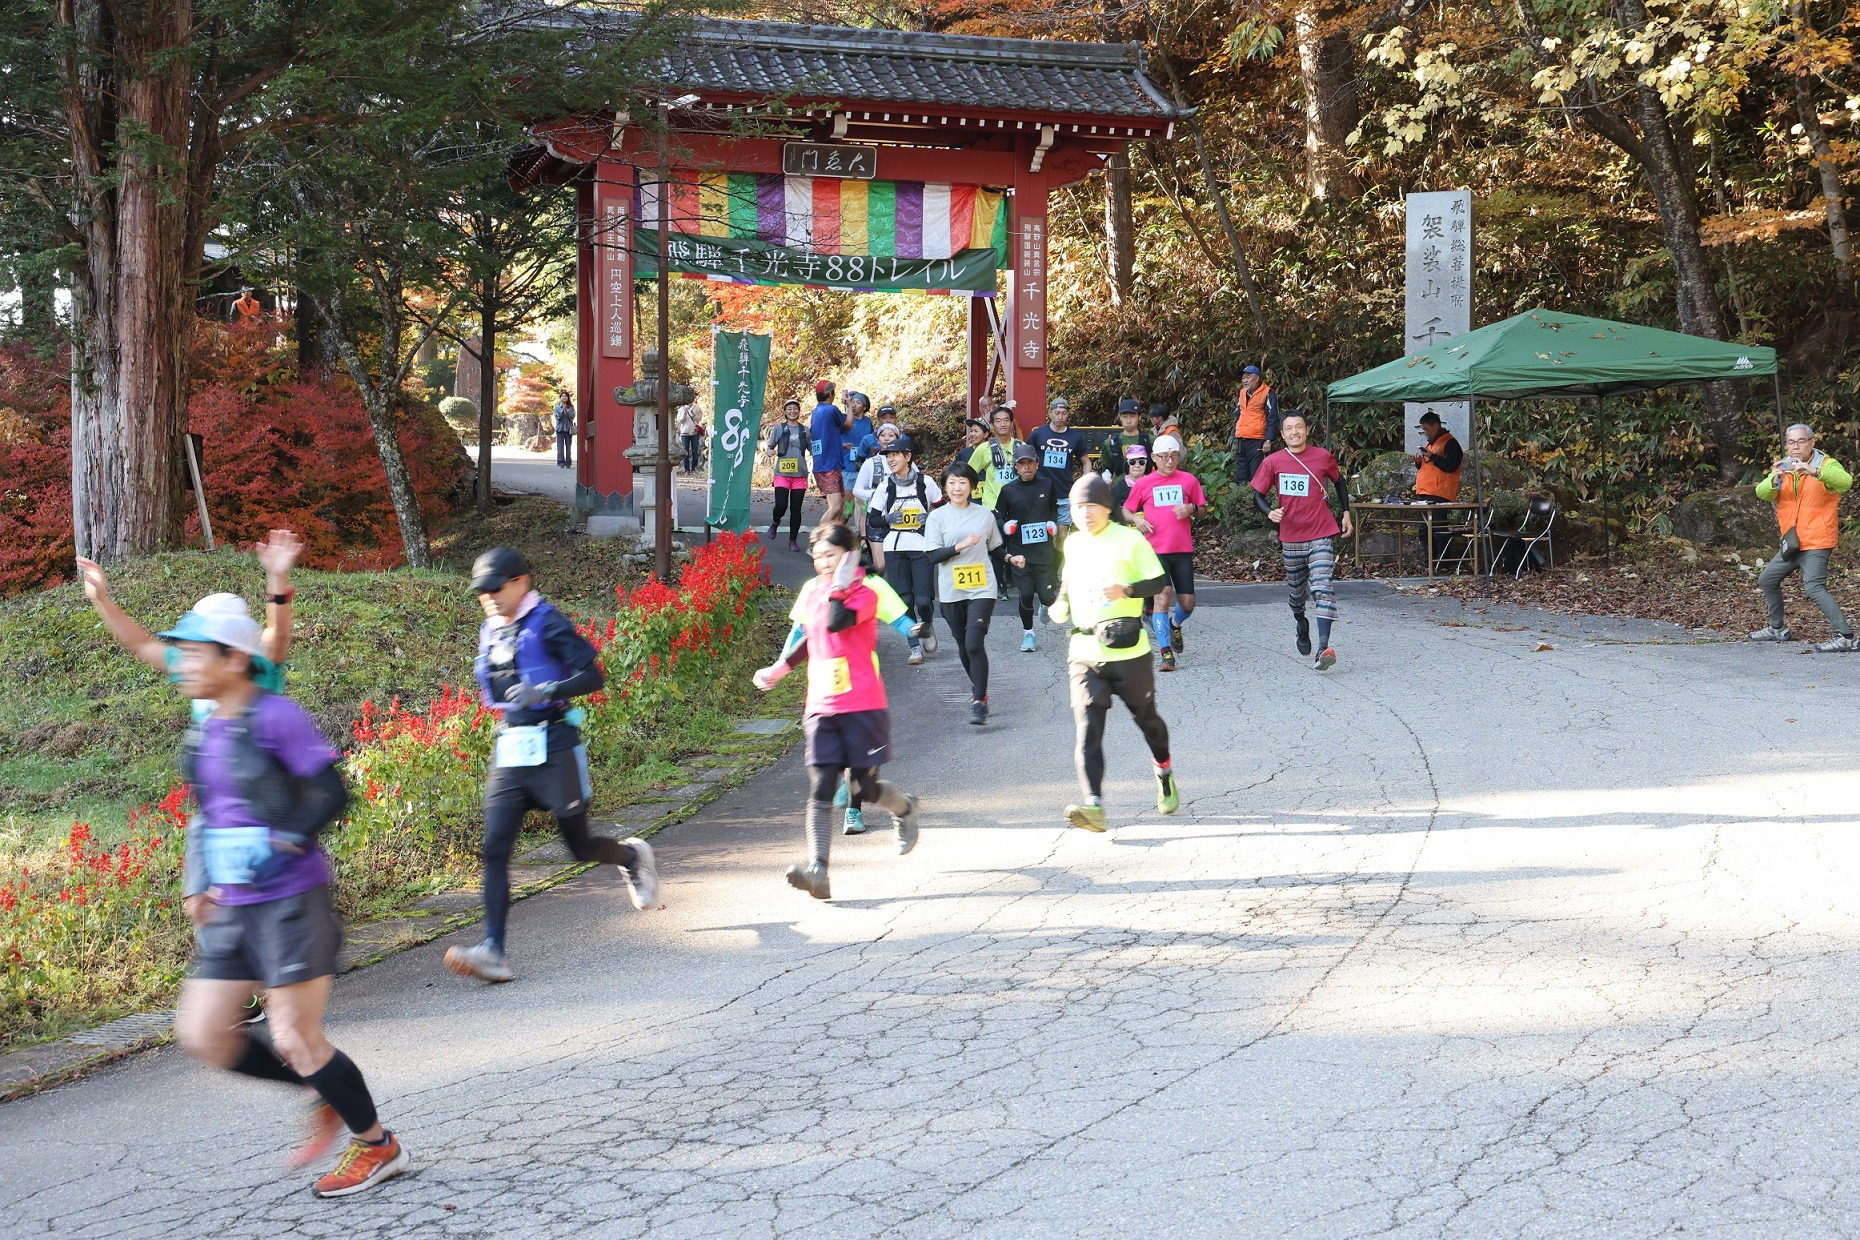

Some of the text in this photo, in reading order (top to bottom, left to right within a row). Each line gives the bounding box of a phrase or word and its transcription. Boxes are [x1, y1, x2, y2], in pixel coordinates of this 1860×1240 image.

[1022, 281, 1041, 359] 千光寺
[1048, 455, 1064, 465] 134
[781, 462, 796, 470] 209
[1284, 480, 1305, 491] 136
[1159, 490, 1178, 501] 117
[903, 513, 918, 525] 07
[1025, 528, 1045, 540] 123
[958, 571, 980, 584] 211
